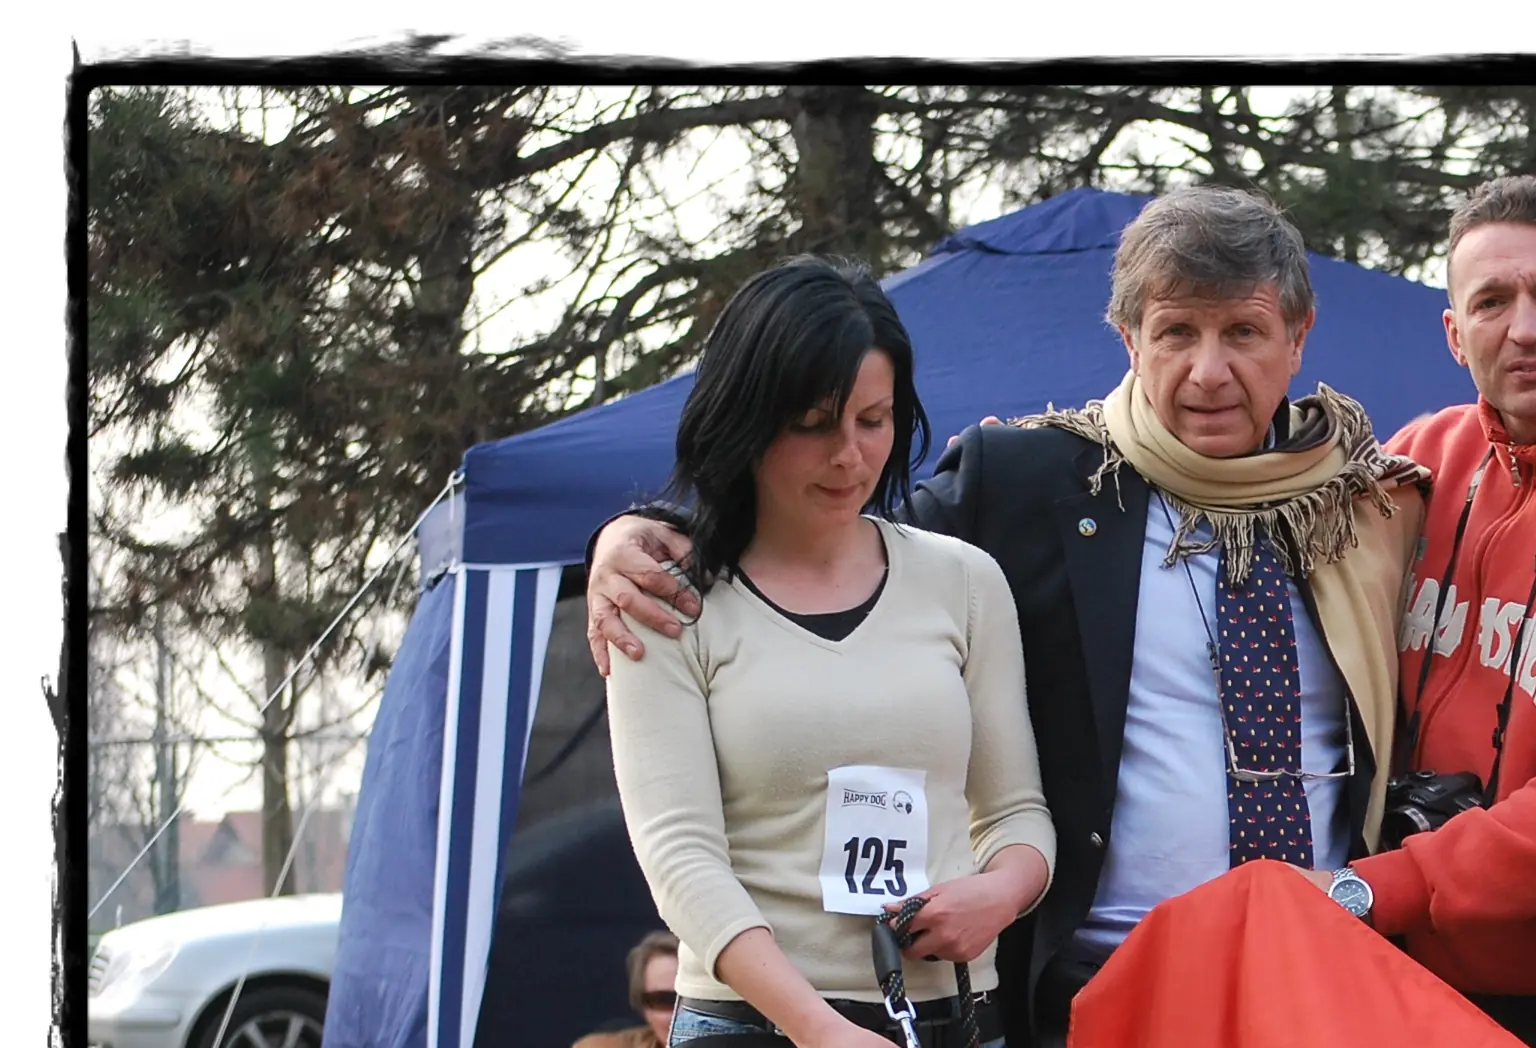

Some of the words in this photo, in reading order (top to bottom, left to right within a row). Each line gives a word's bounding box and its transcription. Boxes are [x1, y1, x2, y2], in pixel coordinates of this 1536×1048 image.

[843, 791, 870, 805] HAPPY
[870, 792, 887, 807] DOG
[843, 836, 908, 897] 125
